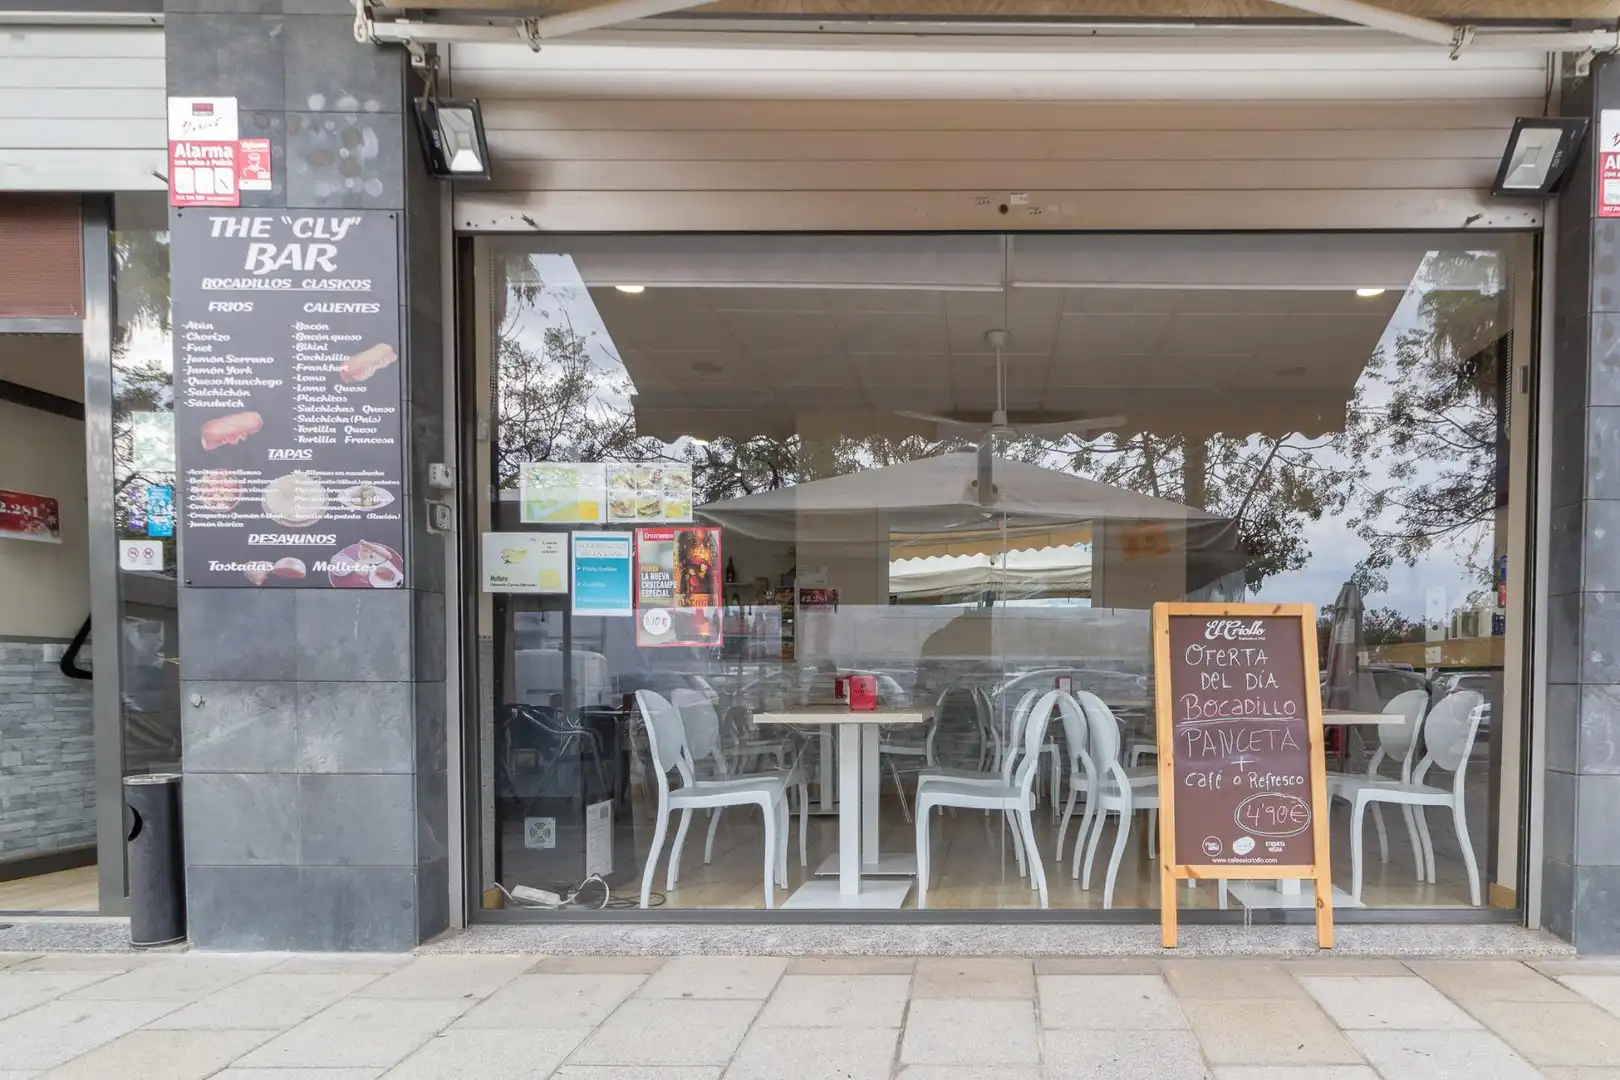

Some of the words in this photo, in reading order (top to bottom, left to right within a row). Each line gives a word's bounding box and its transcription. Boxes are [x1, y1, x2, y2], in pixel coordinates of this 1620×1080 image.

[174, 142, 233, 159] Alarma
[209, 216, 274, 238] THE
[244, 242, 337, 275] BAR
[202, 278, 292, 290] BOCADILLOS
[302, 279, 371, 290] CLASICOS
[208, 301, 254, 313] FRIOS
[303, 302, 380, 313] CALIENTES
[330, 334, 362, 343] queso
[225, 354, 274, 364] Serrano
[226, 365, 253, 375] York
[224, 376, 283, 388] Manchego
[334, 384, 367, 394] Queso
[362, 404, 395, 414] Queso
[344, 425, 377, 435] Queso
[344, 435, 395, 444] Francesa
[268, 449, 313, 459] TAPAS
[248, 533, 336, 544] DESAYUNOS
[208, 560, 274, 572] Tostadas
[312, 560, 376, 572] Molletes
[1224, 620, 1266, 640] Criollo
[1181, 727, 1300, 758] PANCETA
[1247, 771, 1304, 790] Refresco
